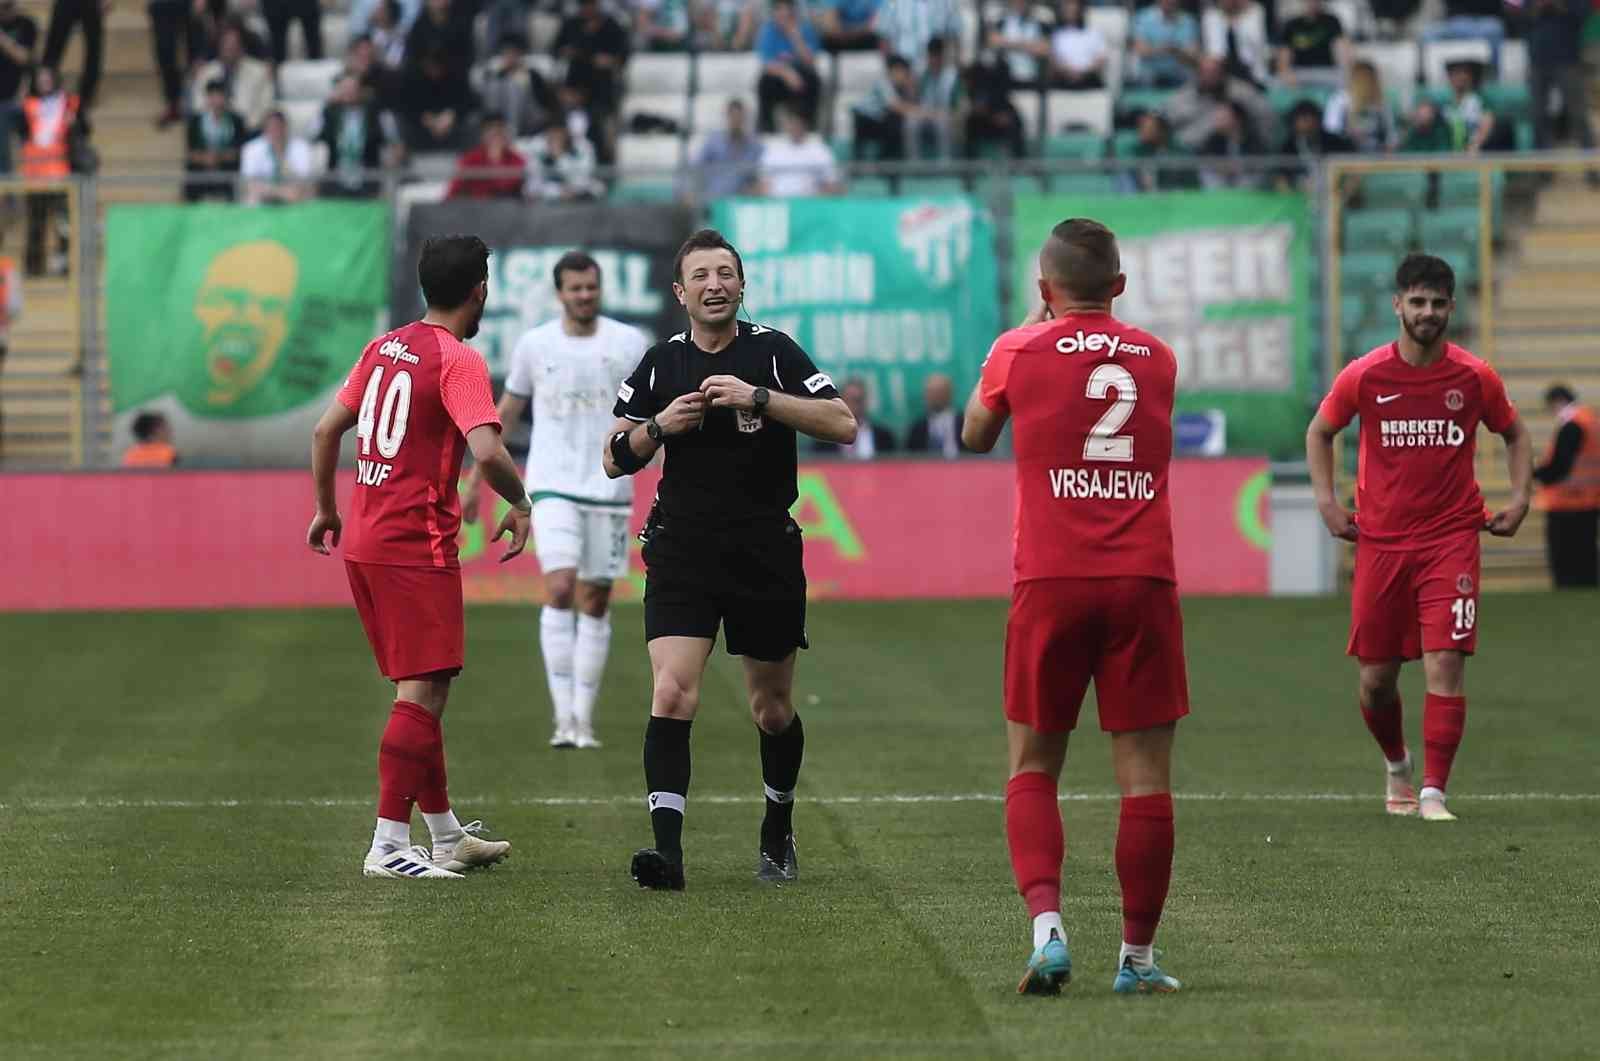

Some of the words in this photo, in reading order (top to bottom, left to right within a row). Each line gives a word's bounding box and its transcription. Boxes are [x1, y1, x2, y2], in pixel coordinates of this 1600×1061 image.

[1055, 331, 1151, 357] oley.com
[357, 365, 413, 459] 40
[1083, 363, 1138, 462] 2
[1380, 419, 1446, 434] BEREKET
[1451, 598, 1475, 630] 19
